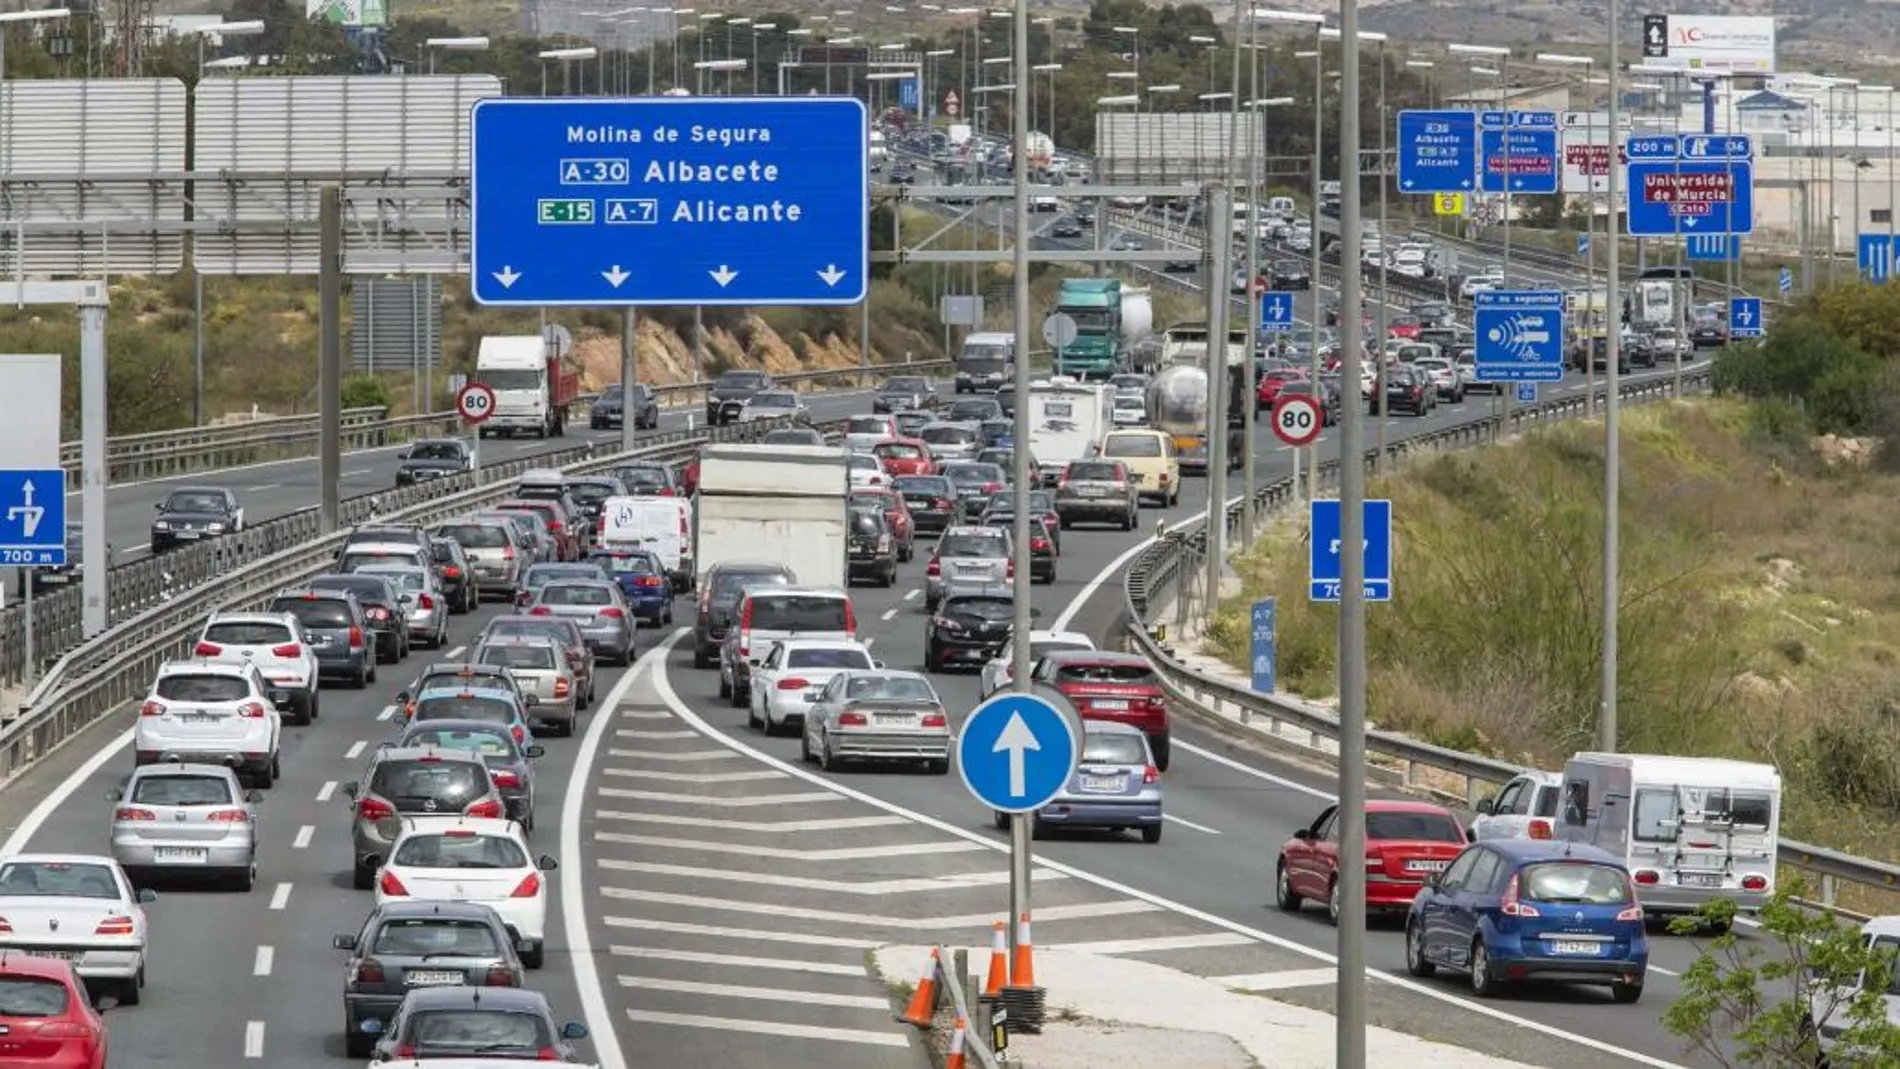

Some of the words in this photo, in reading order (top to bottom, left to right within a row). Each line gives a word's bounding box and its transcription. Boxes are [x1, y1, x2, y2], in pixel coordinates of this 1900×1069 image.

[567, 126, 641, 143] Molina
[653, 126, 678, 143] de
[691, 126, 771, 147] Segura
[1633, 142, 1658, 152] 200
[1663, 143, 1674, 152] m
[565, 163, 624, 180] A-30
[644, 160, 779, 182] Albacete
[1653, 189, 1671, 200] de
[1679, 189, 1726, 200] Murcia
[541, 203, 591, 220] E-15
[609, 203, 653, 220] A-7
[673, 201, 801, 222] Alicante
[466, 395, 487, 408] 80
[1282, 410, 1311, 428] 80
[4, 550, 33, 562] 700
[40, 553, 52, 562] m
